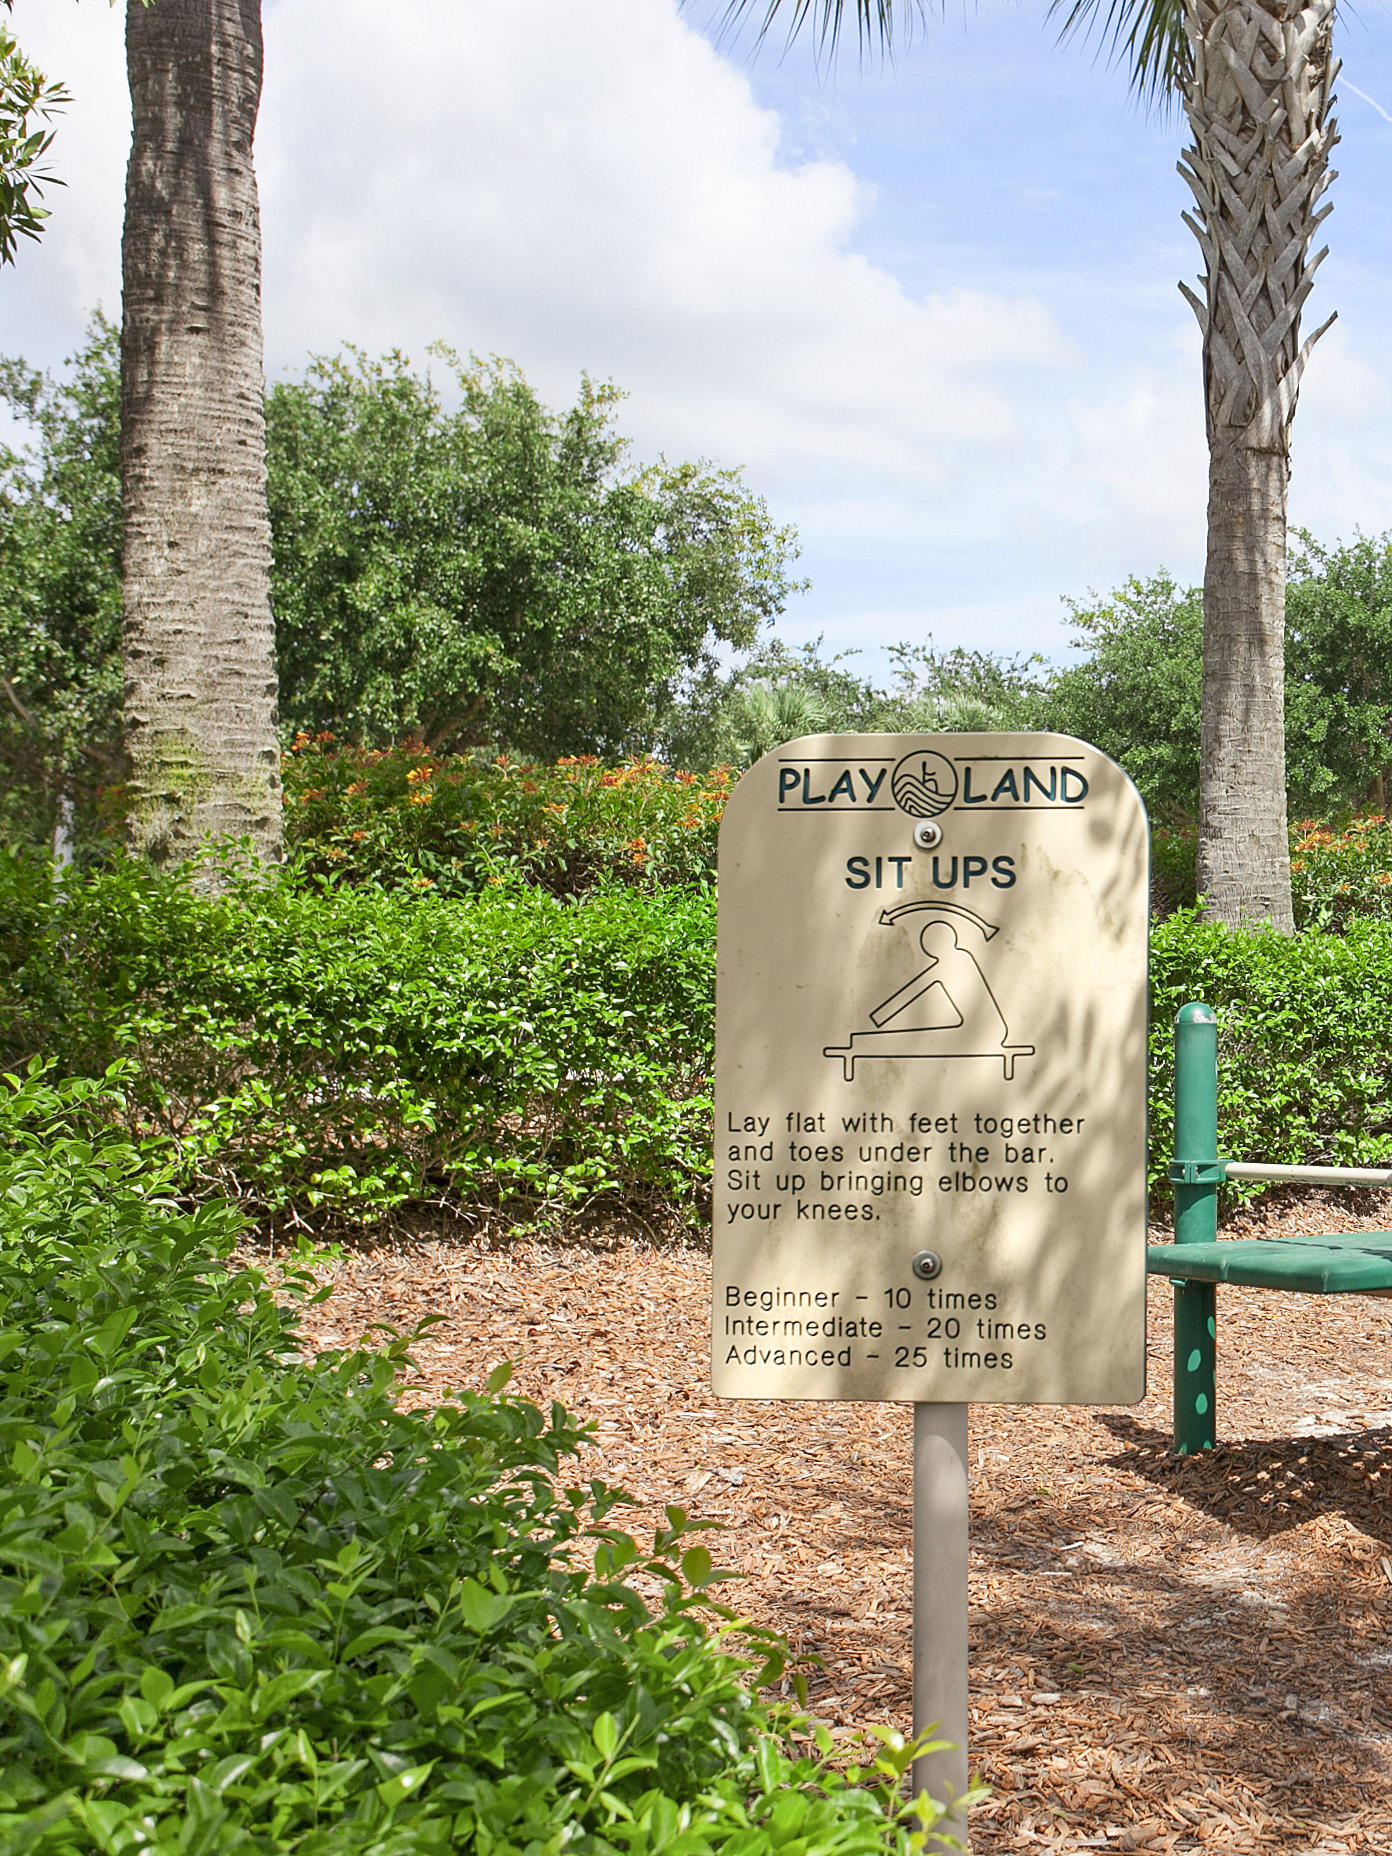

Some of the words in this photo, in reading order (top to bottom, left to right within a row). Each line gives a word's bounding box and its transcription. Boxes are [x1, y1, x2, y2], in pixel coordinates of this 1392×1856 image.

[778, 767, 888, 804] PLAY
[963, 766, 1089, 804] LAND
[845, 855, 912, 889] SIT
[932, 855, 1017, 889] UPS
[727, 1112, 771, 1138] Lay
[786, 1112, 826, 1134] flat
[842, 1112, 894, 1134] with
[909, 1113, 958, 1134] feet
[974, 1114, 1085, 1139] together
[727, 1142, 773, 1162] and
[789, 1143, 843, 1163] toes
[859, 1142, 933, 1163] under
[948, 1142, 989, 1163] the
[1005, 1143, 1054, 1163] bar.
[727, 1170, 761, 1192] Sit
[776, 1174, 805, 1196] up
[821, 1171, 923, 1196] bringing
[938, 1172, 1028, 1193] elbows
[1046, 1173, 1069, 1193] to
[727, 1203, 782, 1224] your
[797, 1200, 881, 1221] knees.
[725, 1286, 839, 1311] Beginner
[884, 1288, 912, 1309] 10
[927, 1289, 998, 1310] times
[724, 1316, 883, 1338] Intermediate
[927, 1317, 961, 1339] 20
[977, 1319, 1047, 1340] times
[725, 1345, 851, 1367] Advanced
[895, 1347, 928, 1368] 25
[944, 1348, 1014, 1369] times
